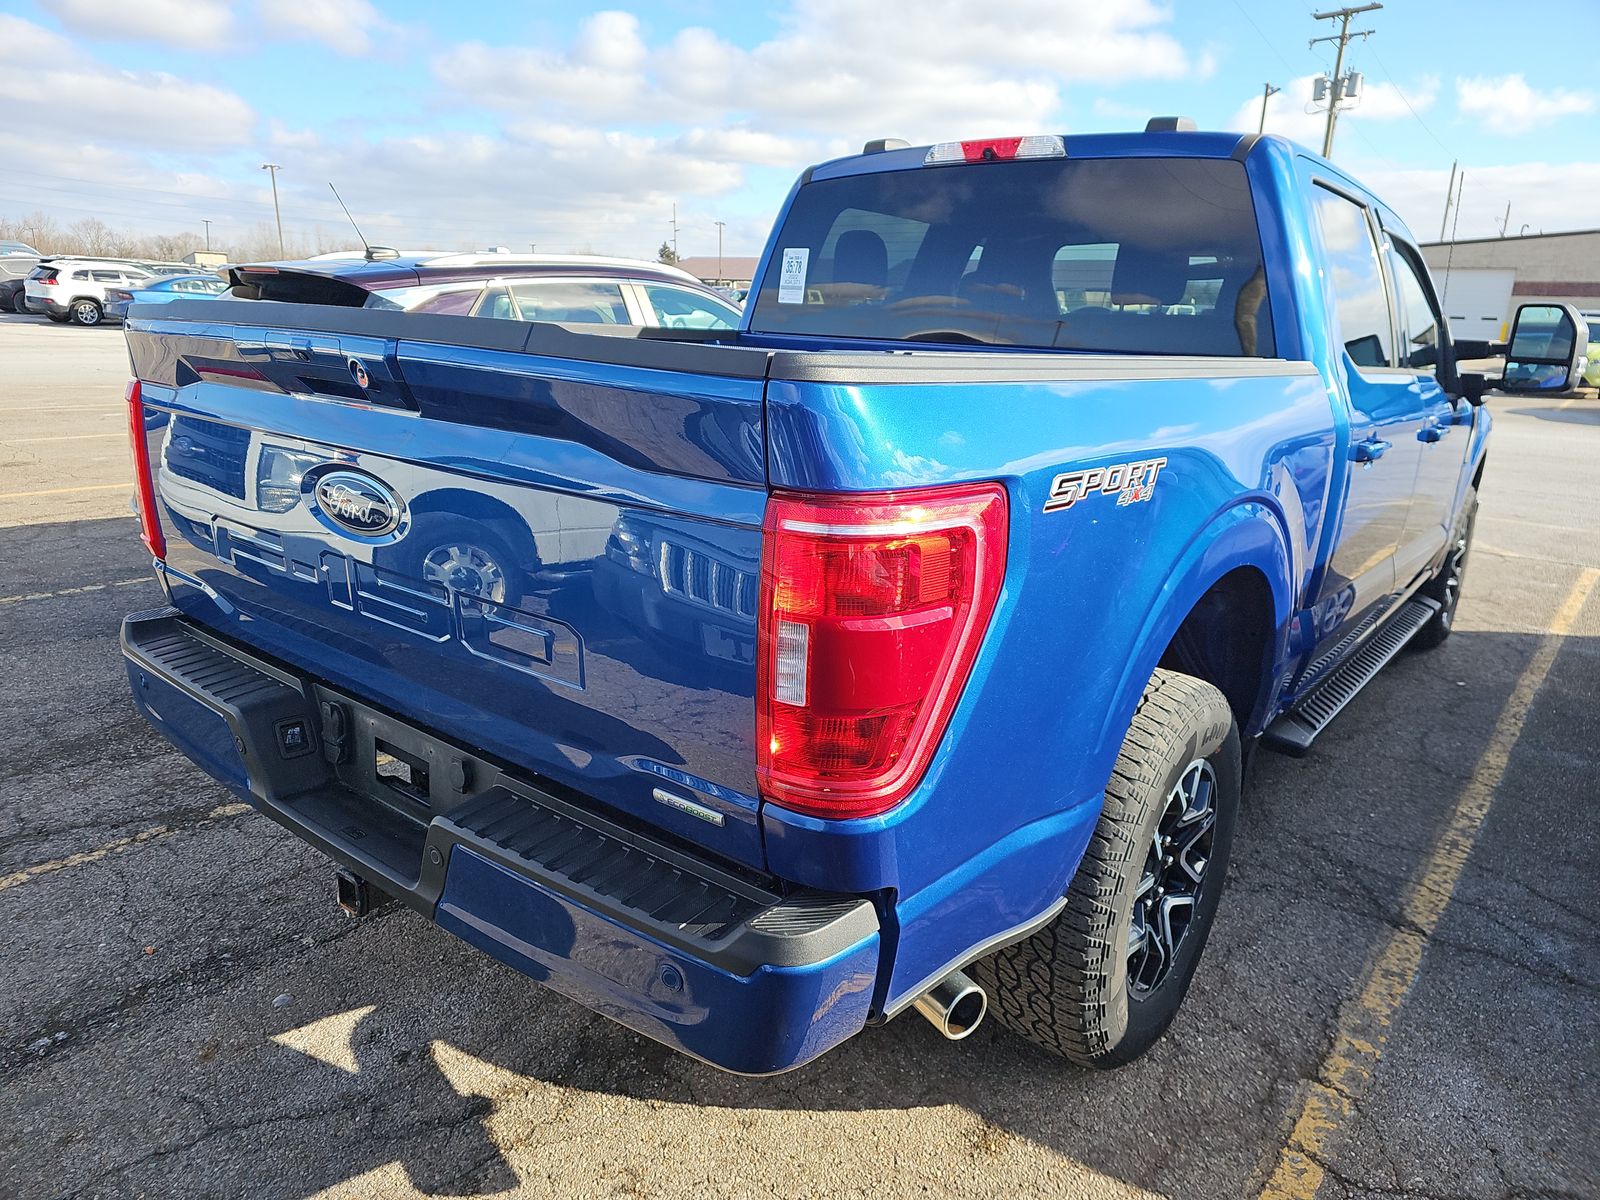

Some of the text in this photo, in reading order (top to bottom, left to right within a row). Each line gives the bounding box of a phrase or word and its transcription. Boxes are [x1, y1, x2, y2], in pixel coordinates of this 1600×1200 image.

[327, 484, 373, 523] Ford
[1043, 457, 1167, 513] SPORT
[210, 513, 586, 691] F-150
[667, 798, 718, 822] ECOBOOST
